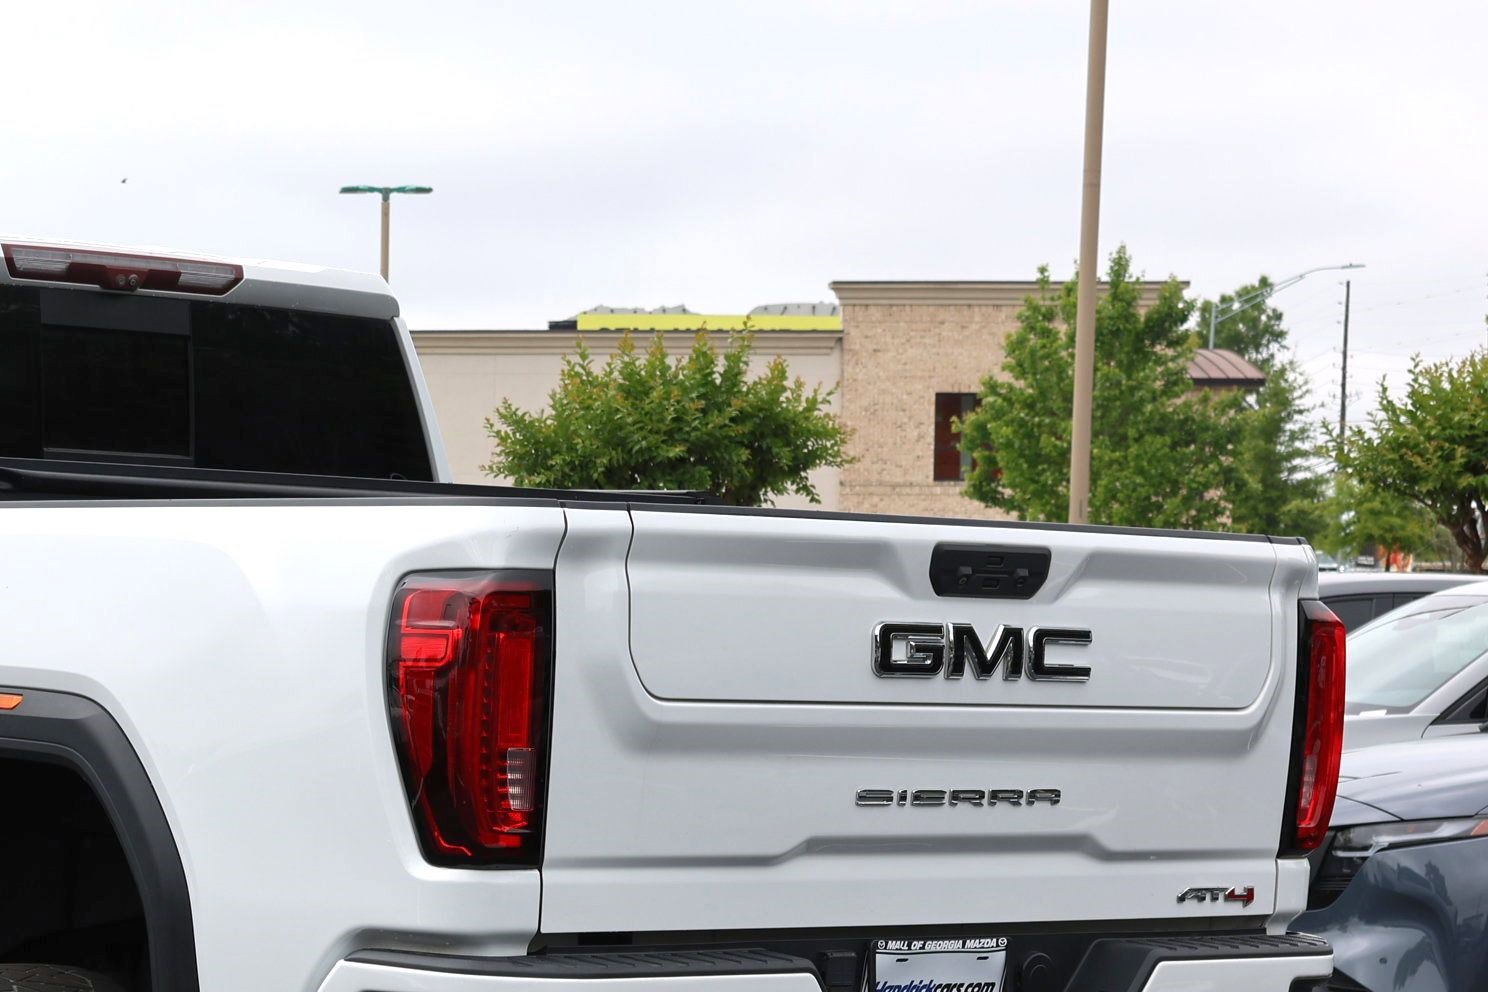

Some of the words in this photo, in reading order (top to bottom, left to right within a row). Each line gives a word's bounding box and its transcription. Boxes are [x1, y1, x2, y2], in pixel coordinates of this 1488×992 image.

[871, 620, 1093, 683] GMC
[855, 788, 1062, 807] SIERRA
[1176, 886, 1255, 908] AT4
[886, 940, 909, 950] MALL
[911, 940, 924, 950] OF
[924, 939, 964, 950] GEORGIA
[964, 938, 997, 949] MAZDA
